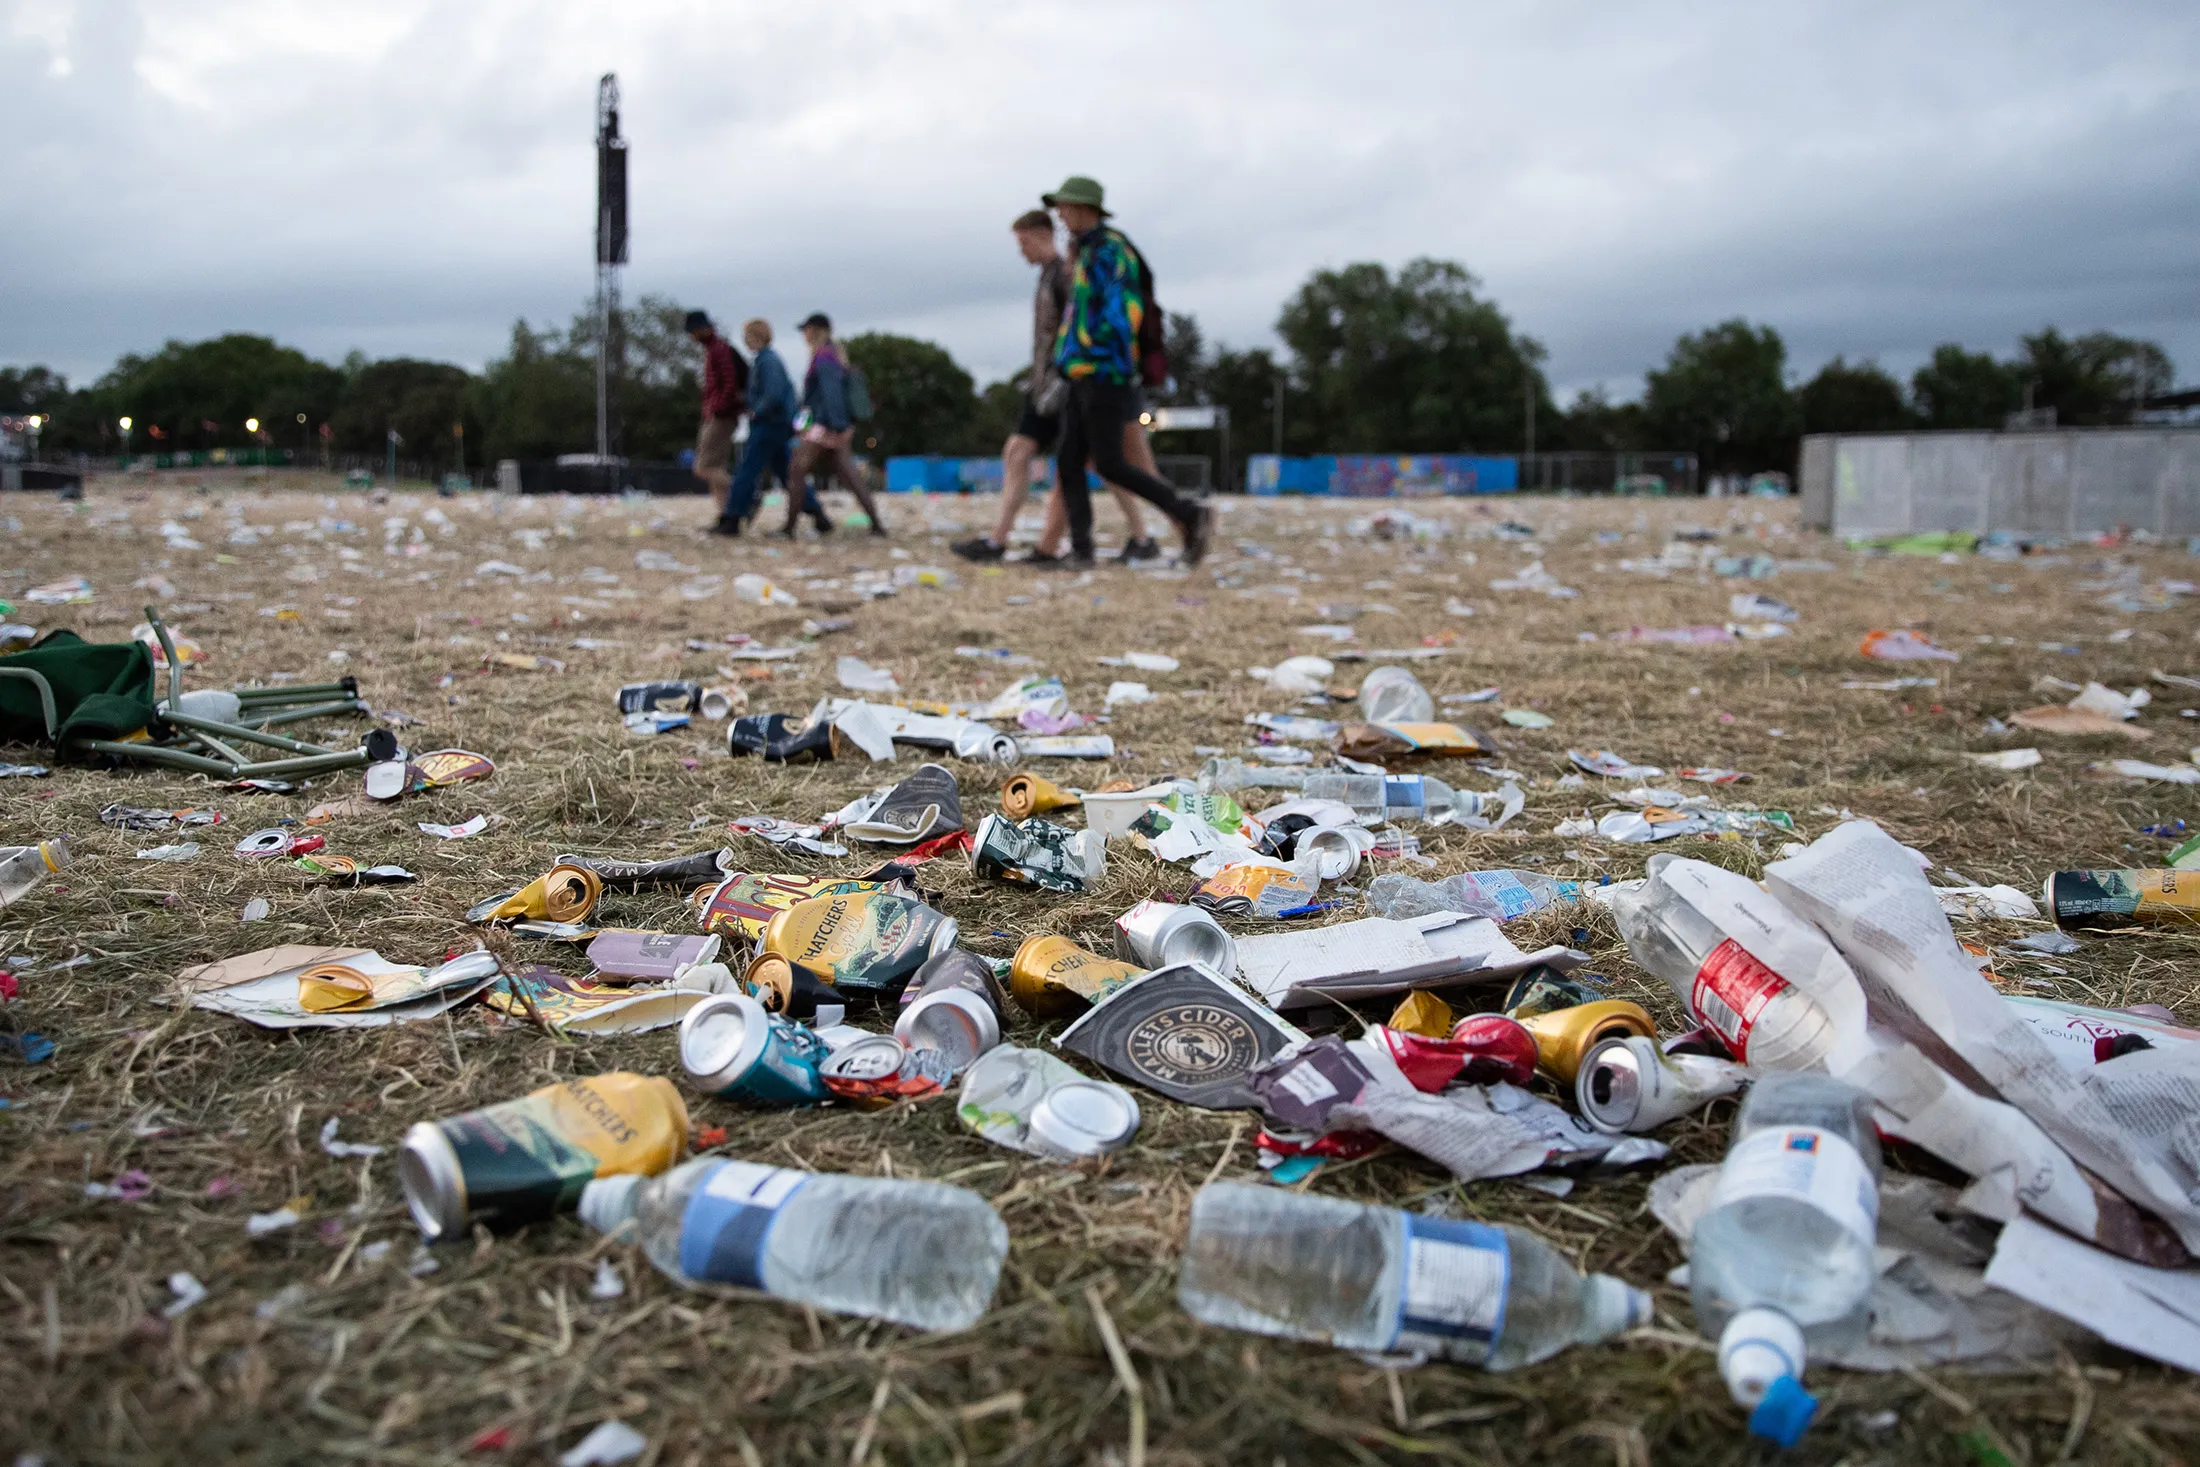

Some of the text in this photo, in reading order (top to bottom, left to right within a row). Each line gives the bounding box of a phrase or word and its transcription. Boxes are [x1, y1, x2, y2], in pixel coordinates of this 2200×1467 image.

[797, 898, 848, 962] THATCHERS
[1134, 1016, 1179, 1080] MALLETS
[1179, 1009, 1246, 1041] CIDER
[2041, 1026, 2094, 1046] SOUTH
